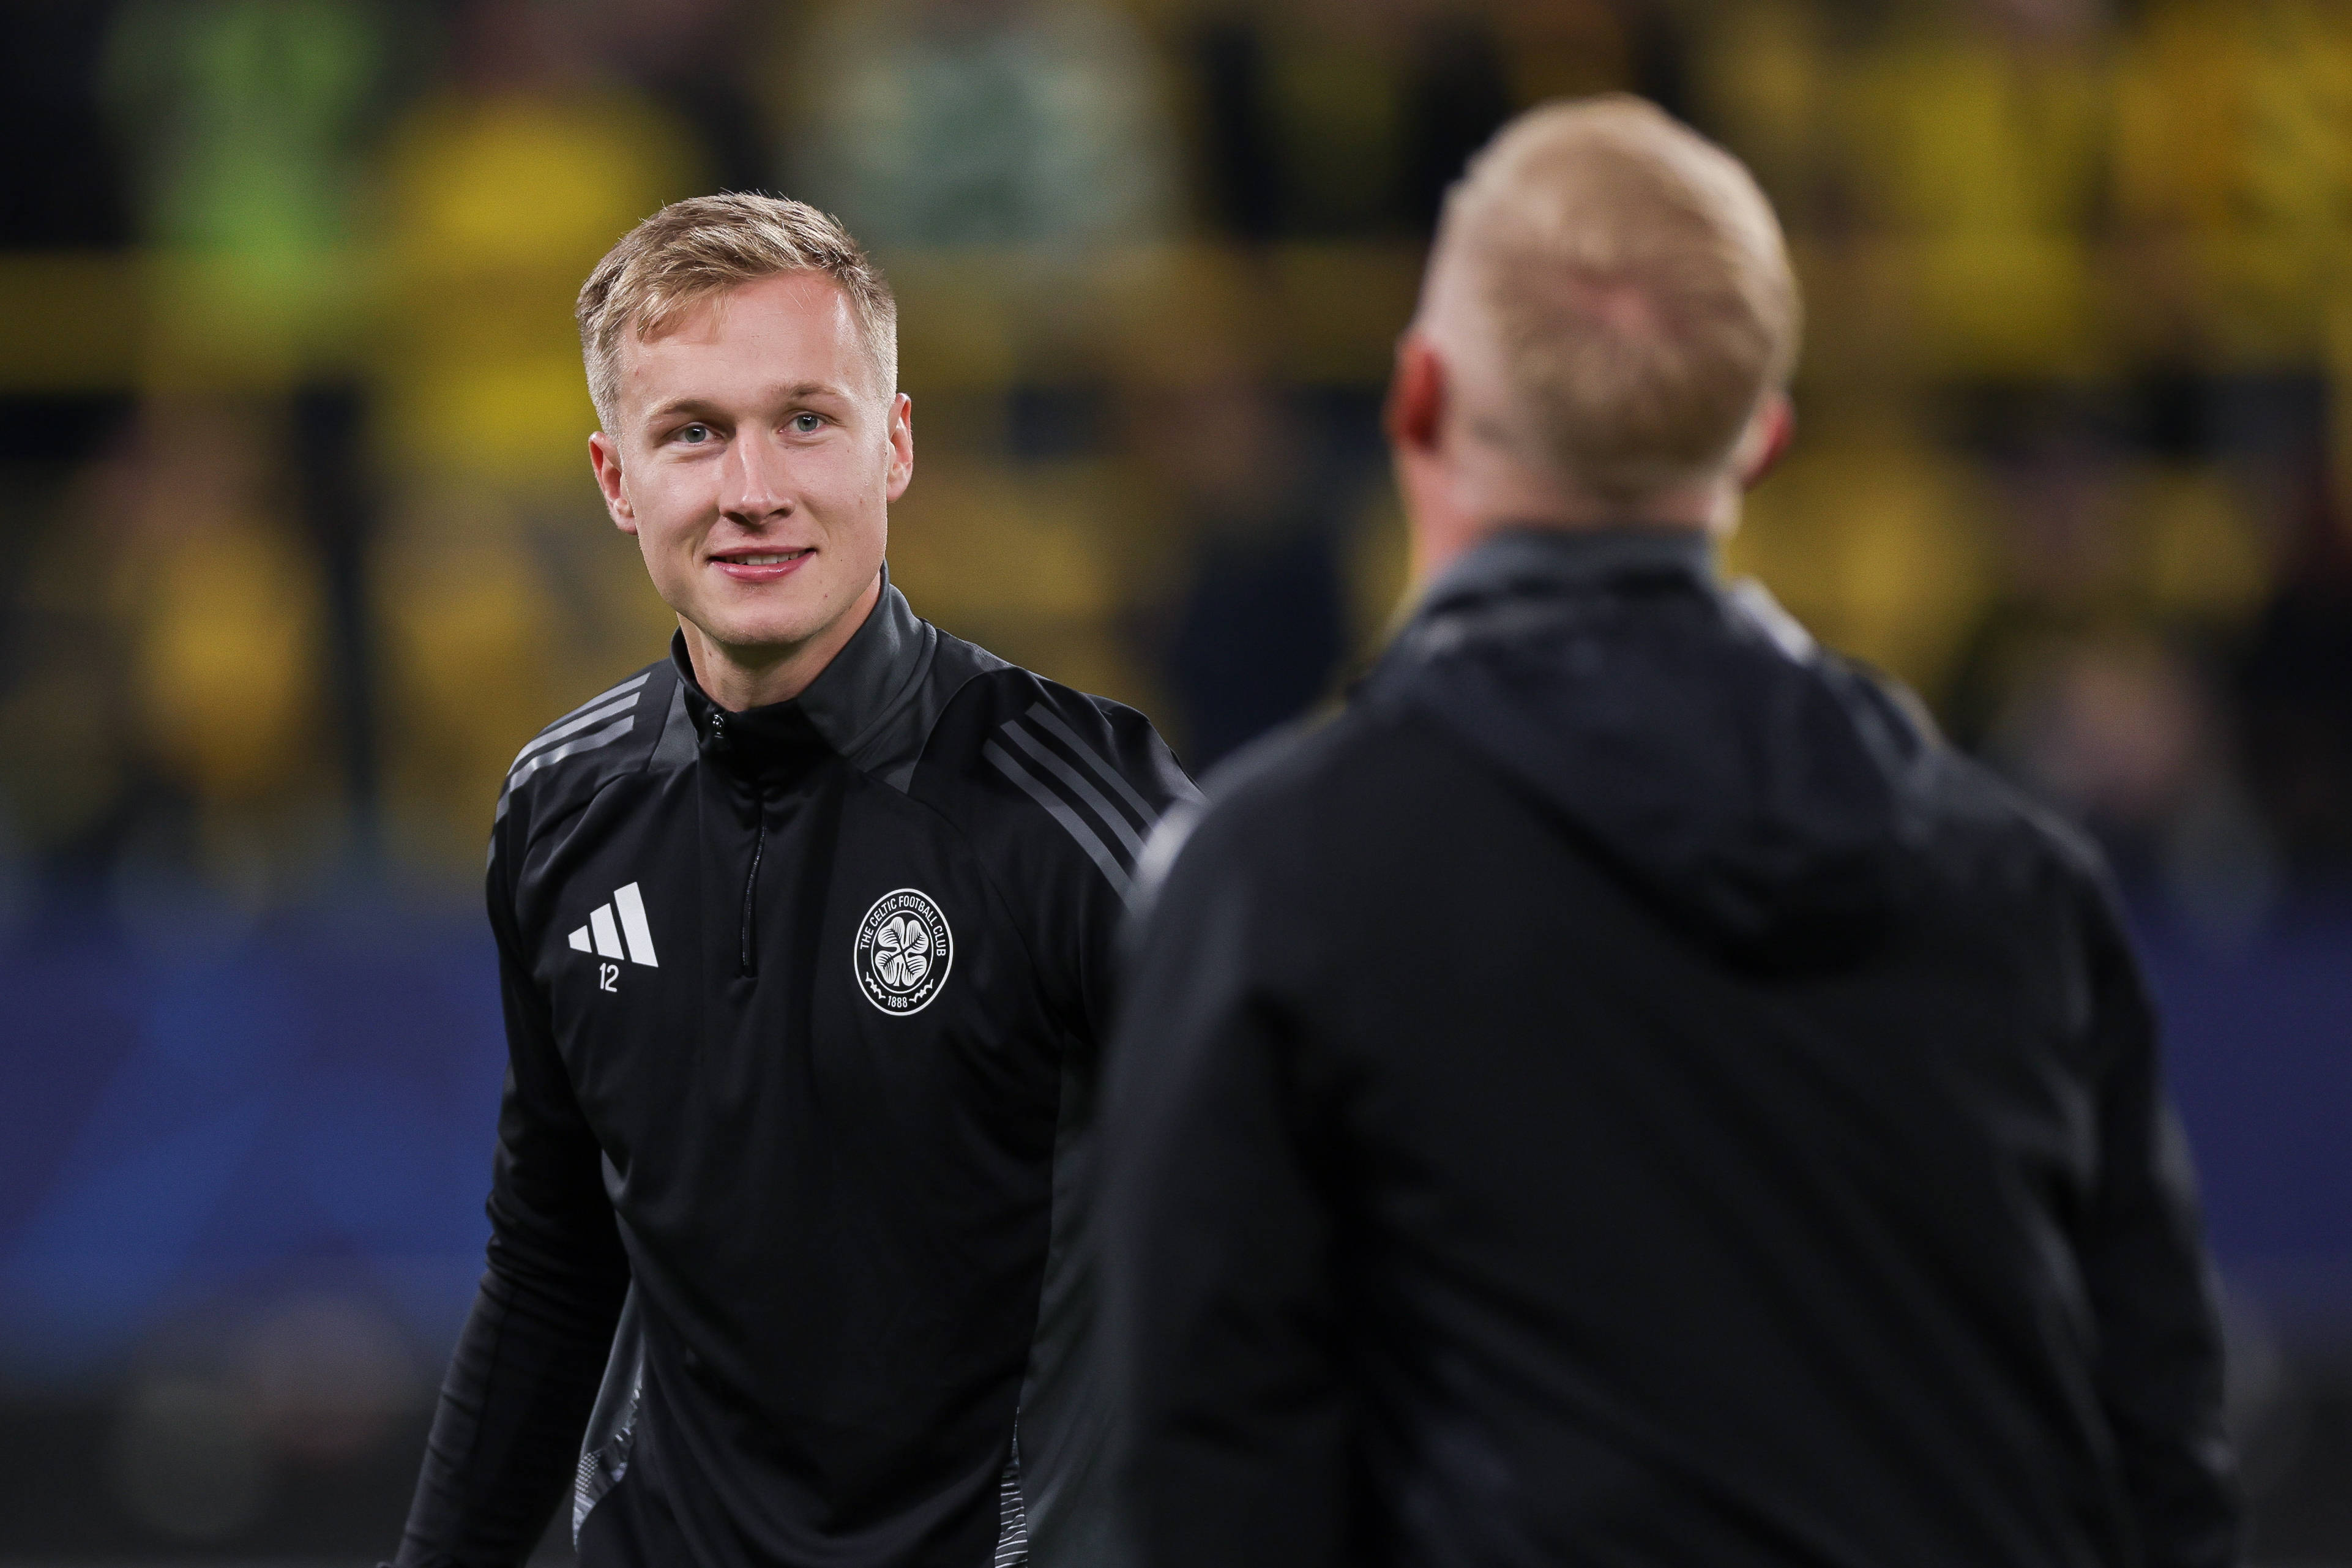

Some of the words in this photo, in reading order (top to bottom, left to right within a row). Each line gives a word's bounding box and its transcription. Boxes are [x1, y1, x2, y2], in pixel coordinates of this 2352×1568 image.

[860, 926, 874, 950] THE
[869, 898, 897, 927] CELTIC
[898, 895, 938, 927] FOOTBALL
[933, 925, 947, 957] CLUB
[599, 962, 619, 993] 12
[887, 995, 908, 1008] 1888
